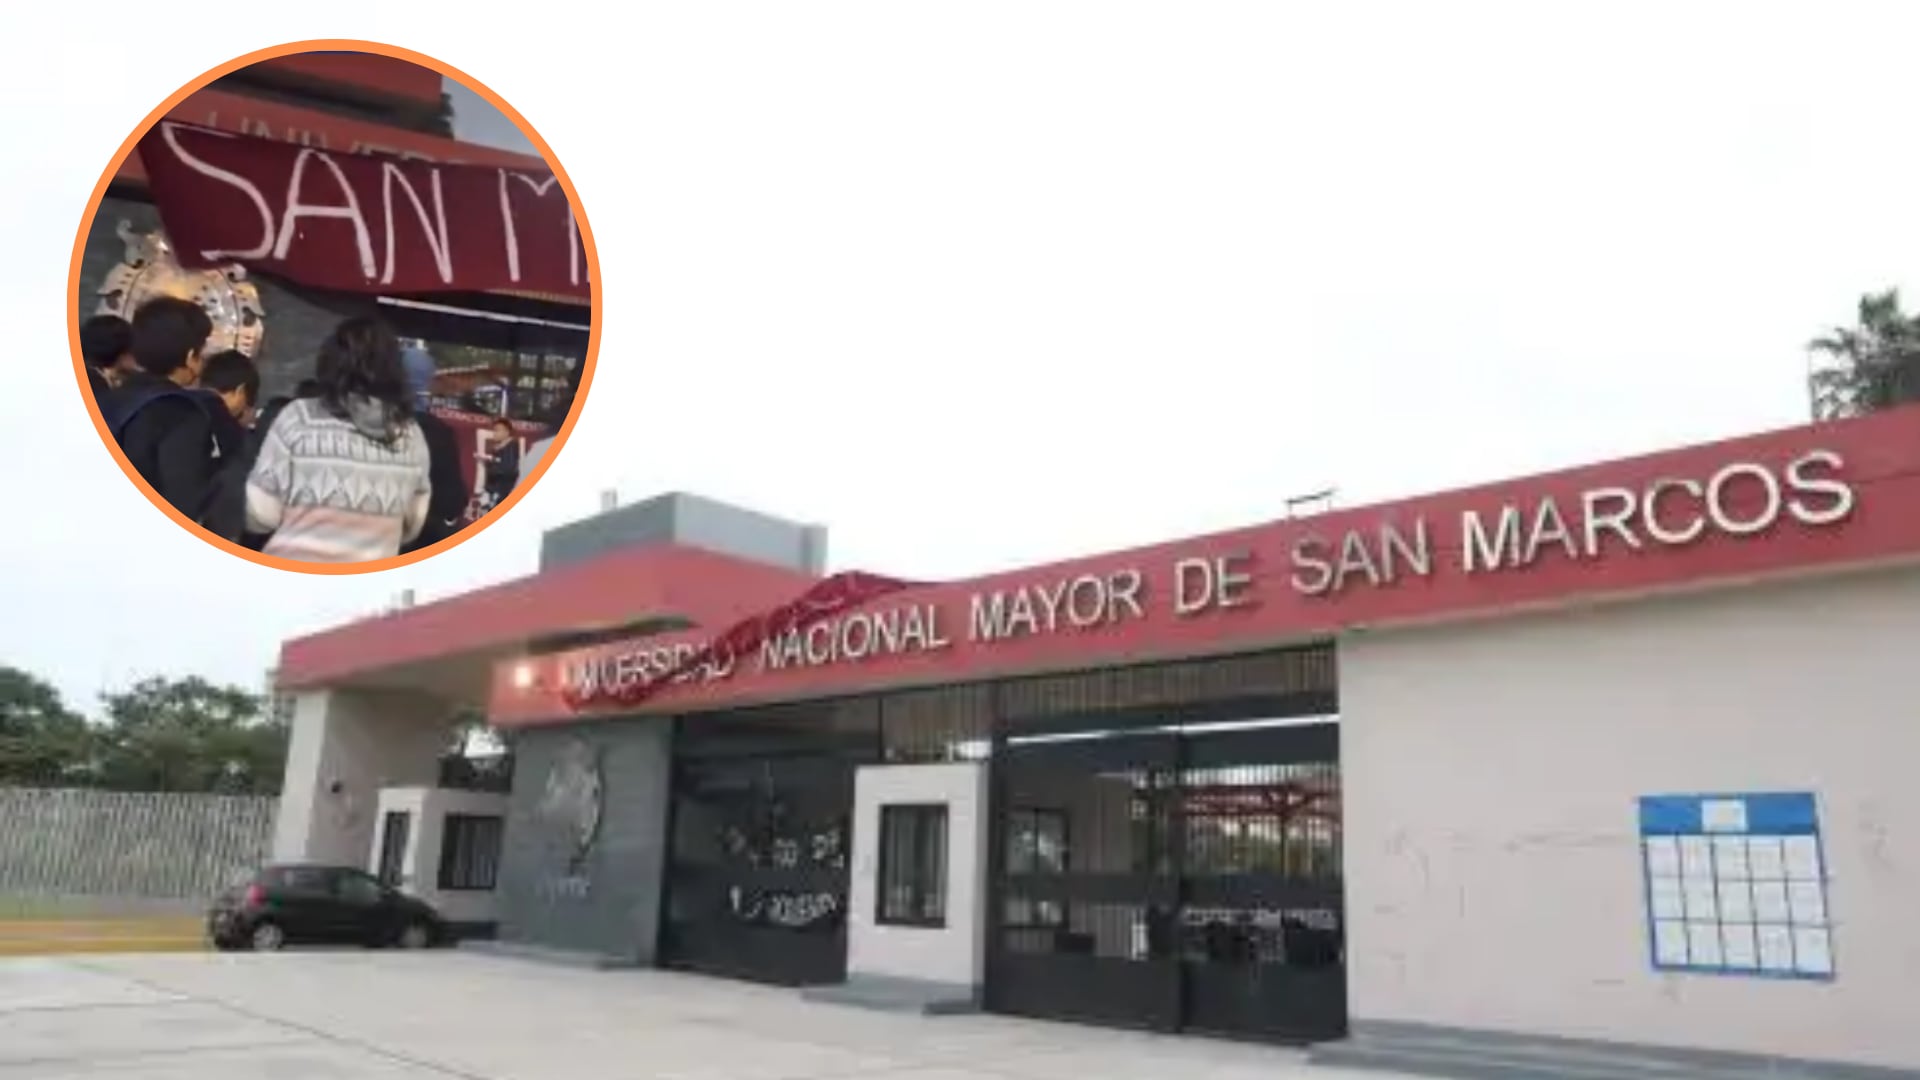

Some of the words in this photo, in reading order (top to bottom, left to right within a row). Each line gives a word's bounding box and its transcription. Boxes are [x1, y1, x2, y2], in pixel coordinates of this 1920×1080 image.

[162, 121, 453, 285] SAN
[499, 166, 592, 287] M
[759, 603, 950, 670] NACIONAL
[969, 568, 1144, 642] MAYOR
[1174, 556, 1252, 614] DE
[1290, 516, 1430, 595] SAN
[1462, 449, 1854, 573] MARCOS
